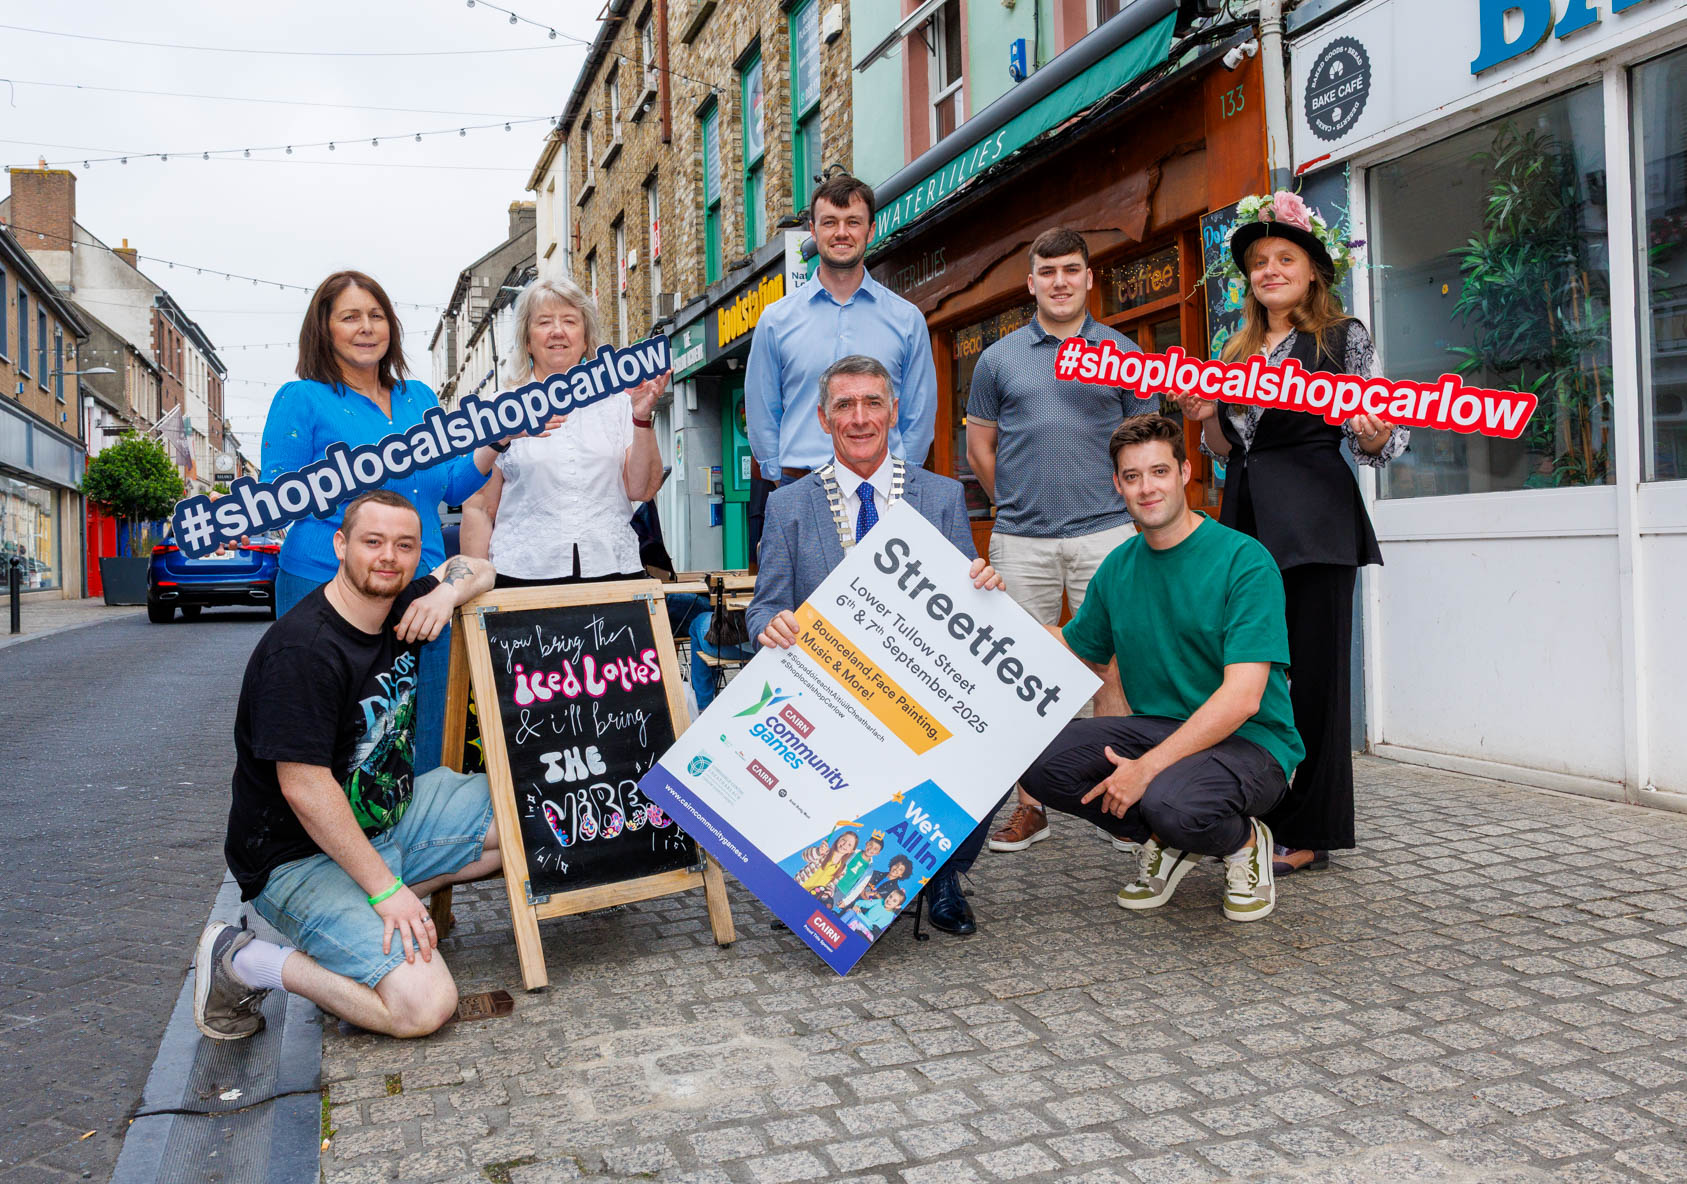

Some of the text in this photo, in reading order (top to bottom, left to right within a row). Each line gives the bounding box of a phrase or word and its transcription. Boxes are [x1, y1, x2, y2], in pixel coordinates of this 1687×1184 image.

[1311, 74, 1364, 110] BAKE CAFÉ
[1312, 46, 1363, 88] BAKED GOODS BREAD
[1219, 84, 1245, 120] 133
[878, 130, 1006, 237] WATERLILIES
[1117, 263, 1173, 304] coffee
[717, 273, 784, 348] Bookstation
[1058, 342, 1530, 433] #shoplocalshopcarlow
[179, 339, 667, 552] #shoplocalshopcarlow
[535, 624, 587, 665] bring
[849, 576, 976, 695] Lower Tullow Street
[873, 537, 1062, 718] Streetfest
[514, 658, 583, 707] iced
[781, 658, 846, 719] #ShoplocalshopCarlow
[801, 631, 875, 701] Music & More!
[835, 594, 988, 734] 6th & 7th September 2025
[515, 701, 652, 748] & i'll bring
[784, 709, 810, 733] CAIRN
[895, 695, 939, 741] Painting,
[539, 745, 607, 784] THE
[748, 722, 804, 770] games
[765, 716, 849, 791] community
[751, 764, 774, 786] CAIRN
[665, 783, 749, 863] www.cairncommunitygames.ie
[885, 820, 937, 871] All In
[904, 799, 952, 852] We're
[813, 916, 841, 943] CAIRN
